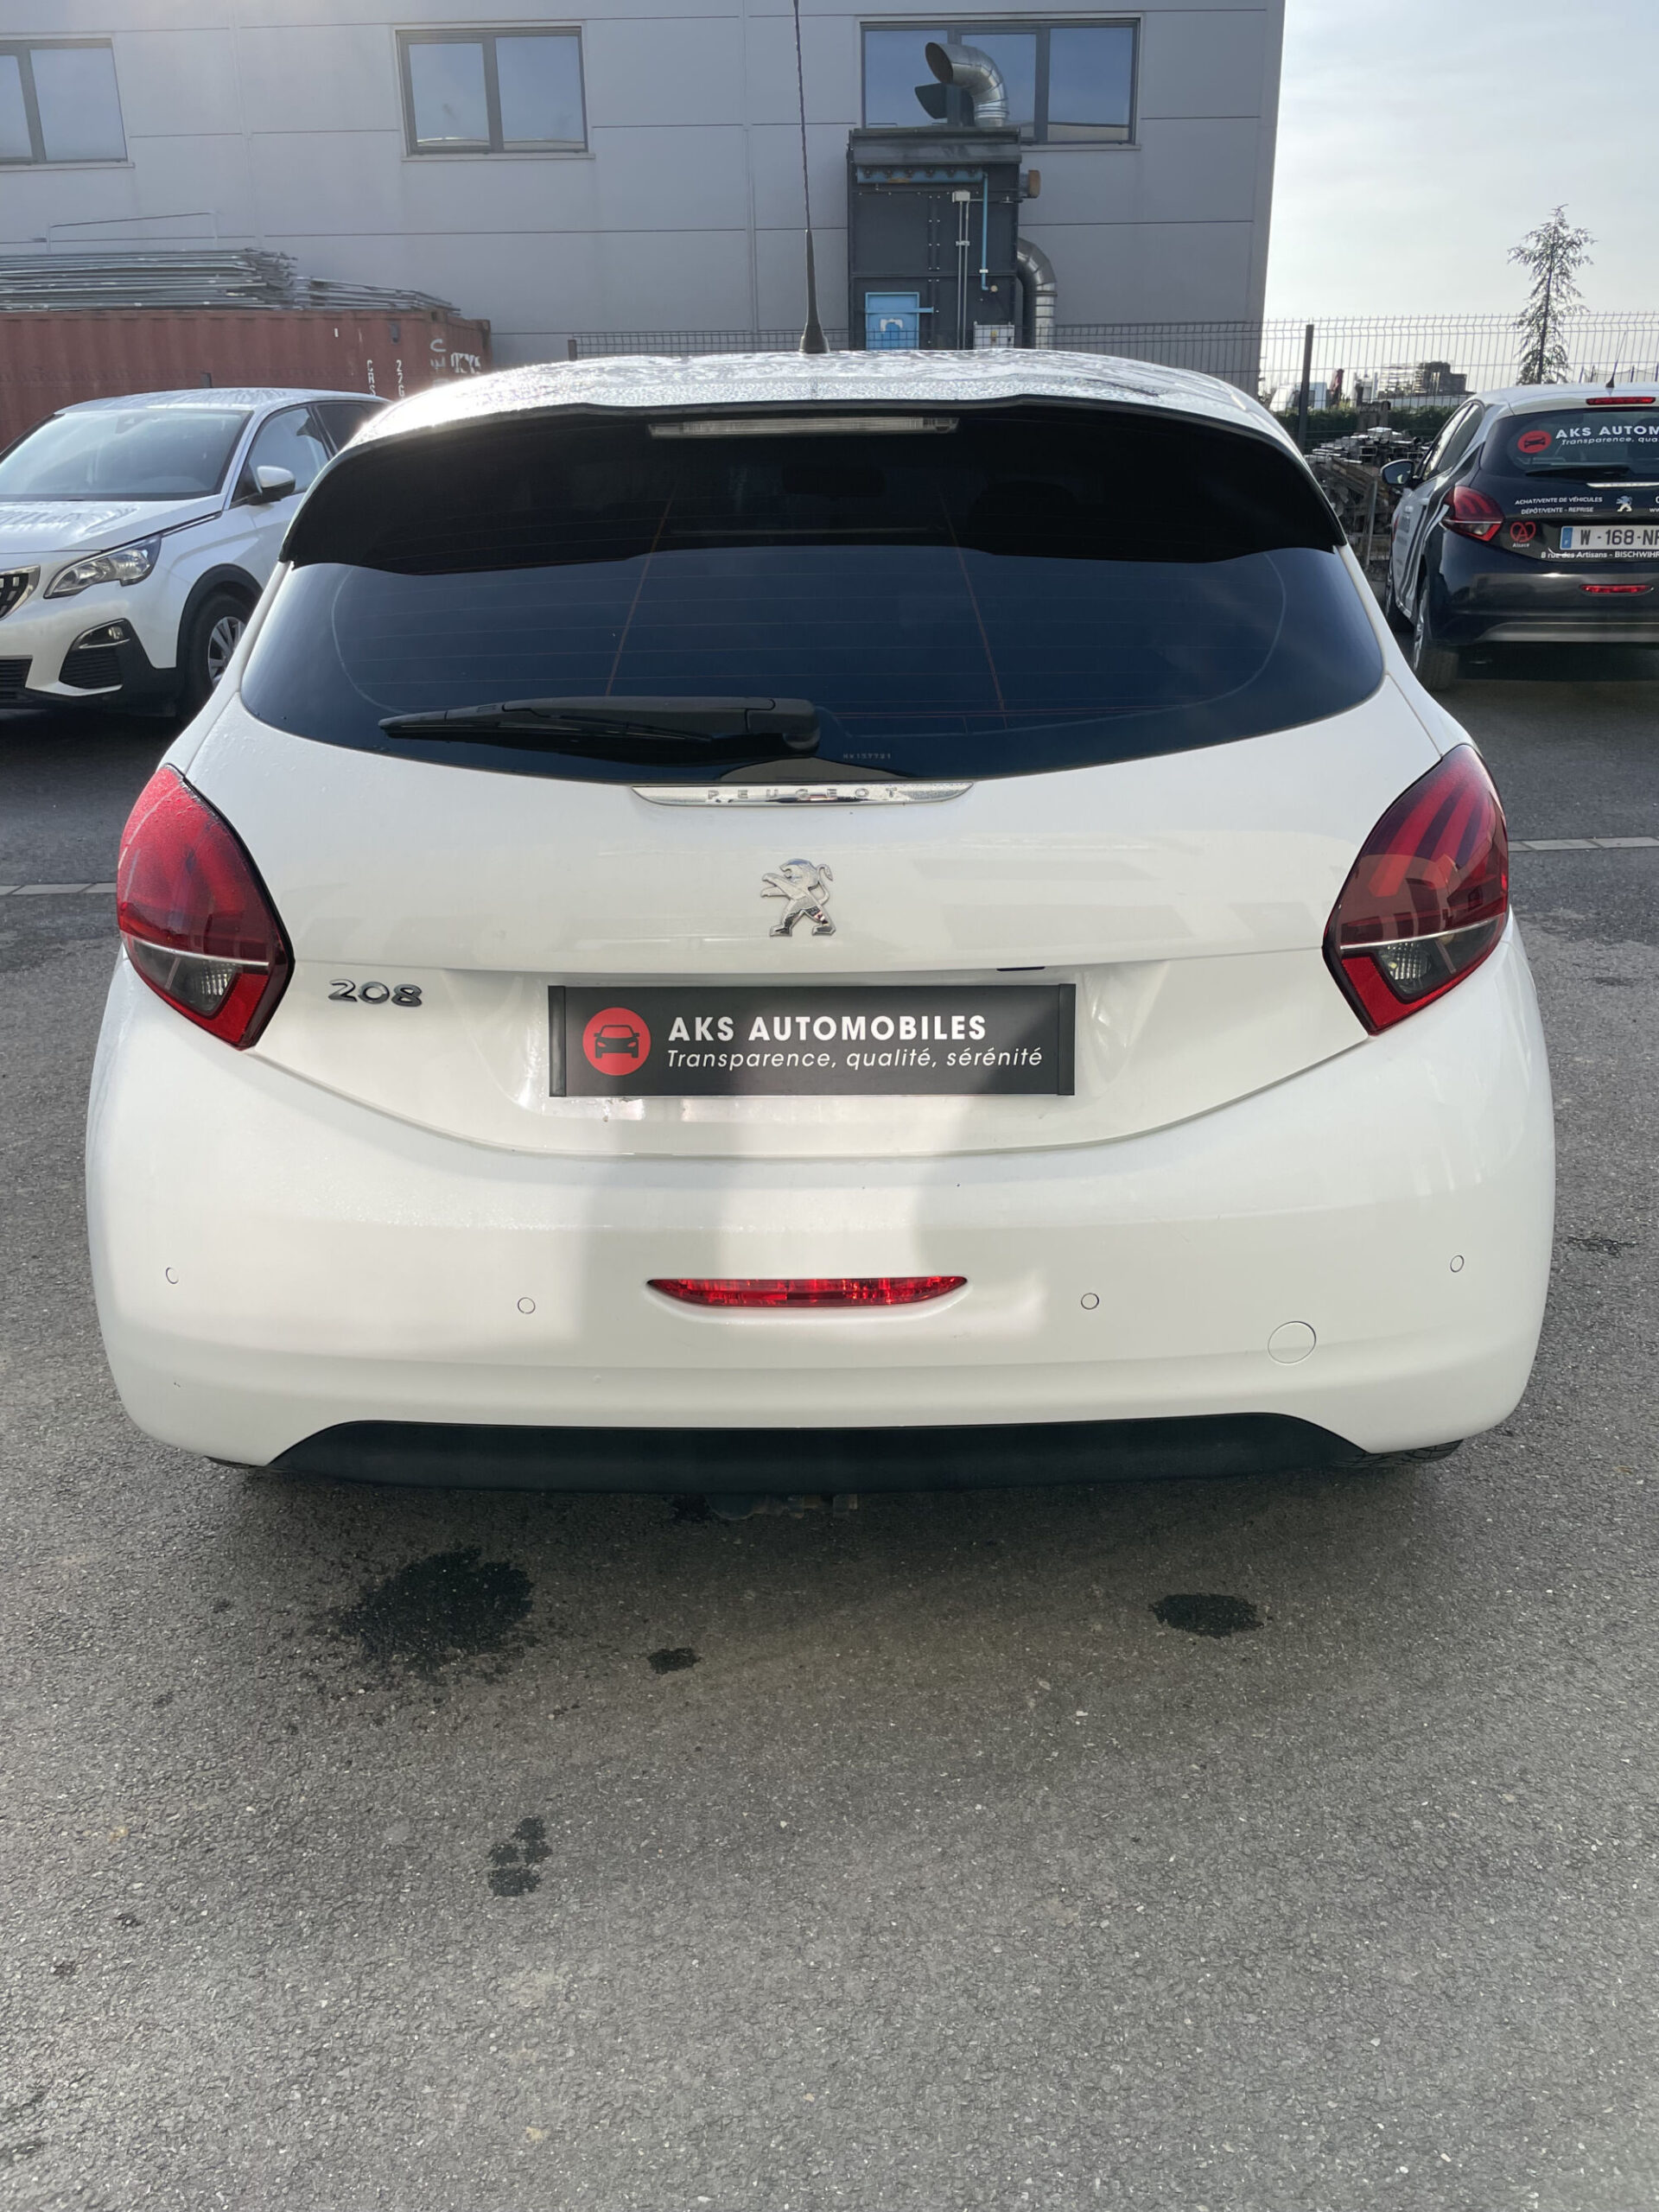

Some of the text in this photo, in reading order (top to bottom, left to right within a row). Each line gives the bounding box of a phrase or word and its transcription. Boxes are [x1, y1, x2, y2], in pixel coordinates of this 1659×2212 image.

[1555, 425, 1659, 439] AKS AUTOM
[1561, 436, 1635, 446] Transparence,
[708, 787, 898, 799] PEUGEOT
[328, 978, 423, 1007] 208
[668, 1015, 986, 1041] AKS AUTOMOBILES
[667, 1047, 1043, 1071] Transparence, qualité, sérénité
